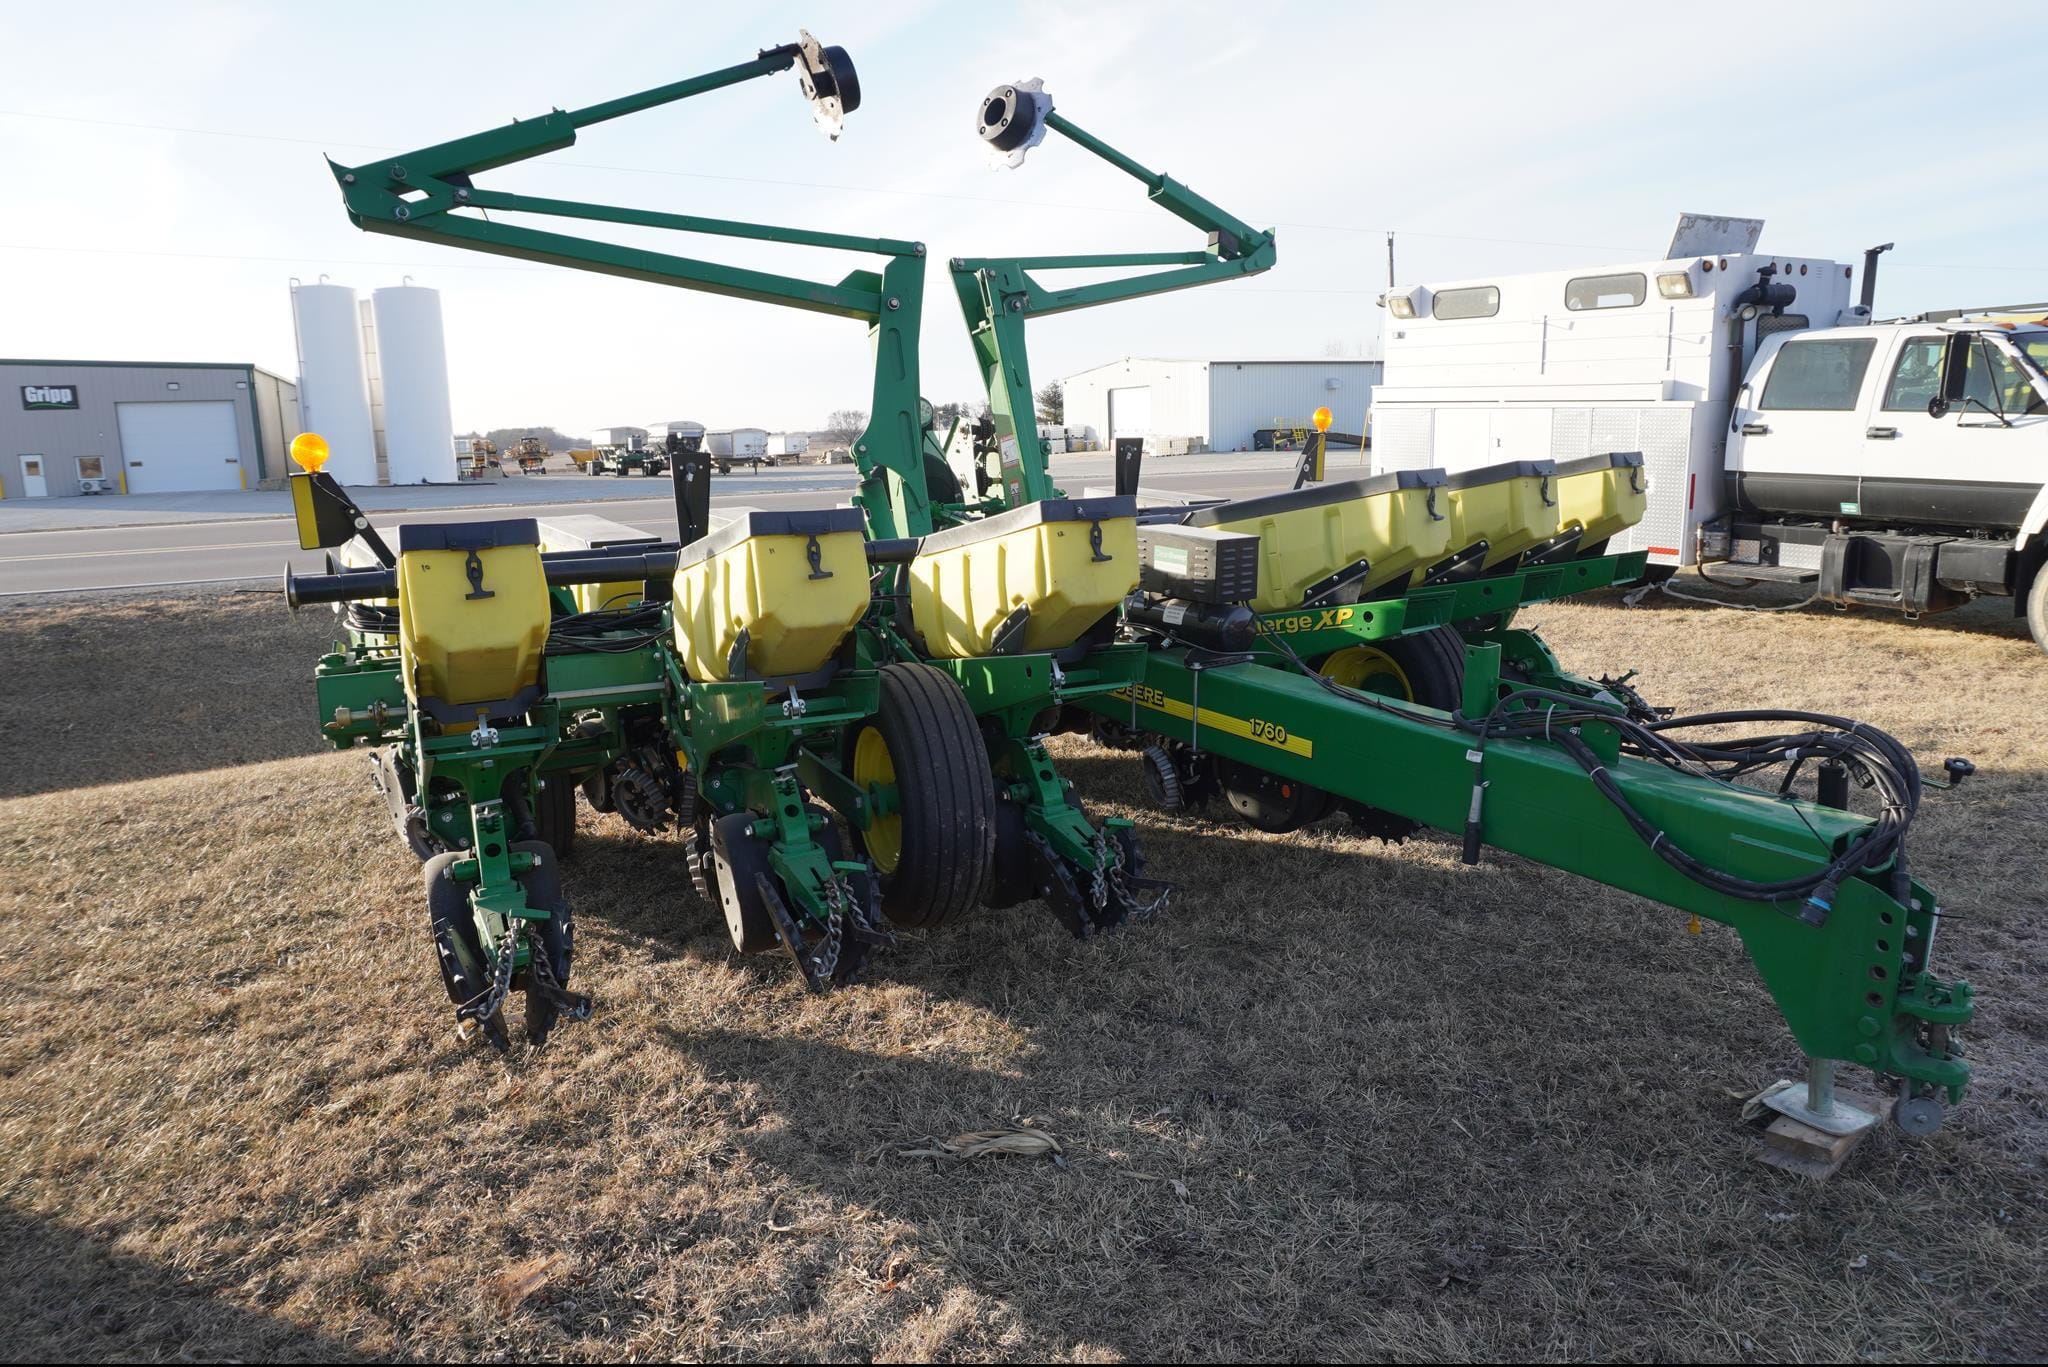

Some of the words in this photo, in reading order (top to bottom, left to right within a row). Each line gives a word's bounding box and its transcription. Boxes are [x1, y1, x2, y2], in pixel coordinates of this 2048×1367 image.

[25, 386, 73, 404] Gripp
[1312, 608, 1354, 632] XP
[1249, 718, 1287, 744] 1760
